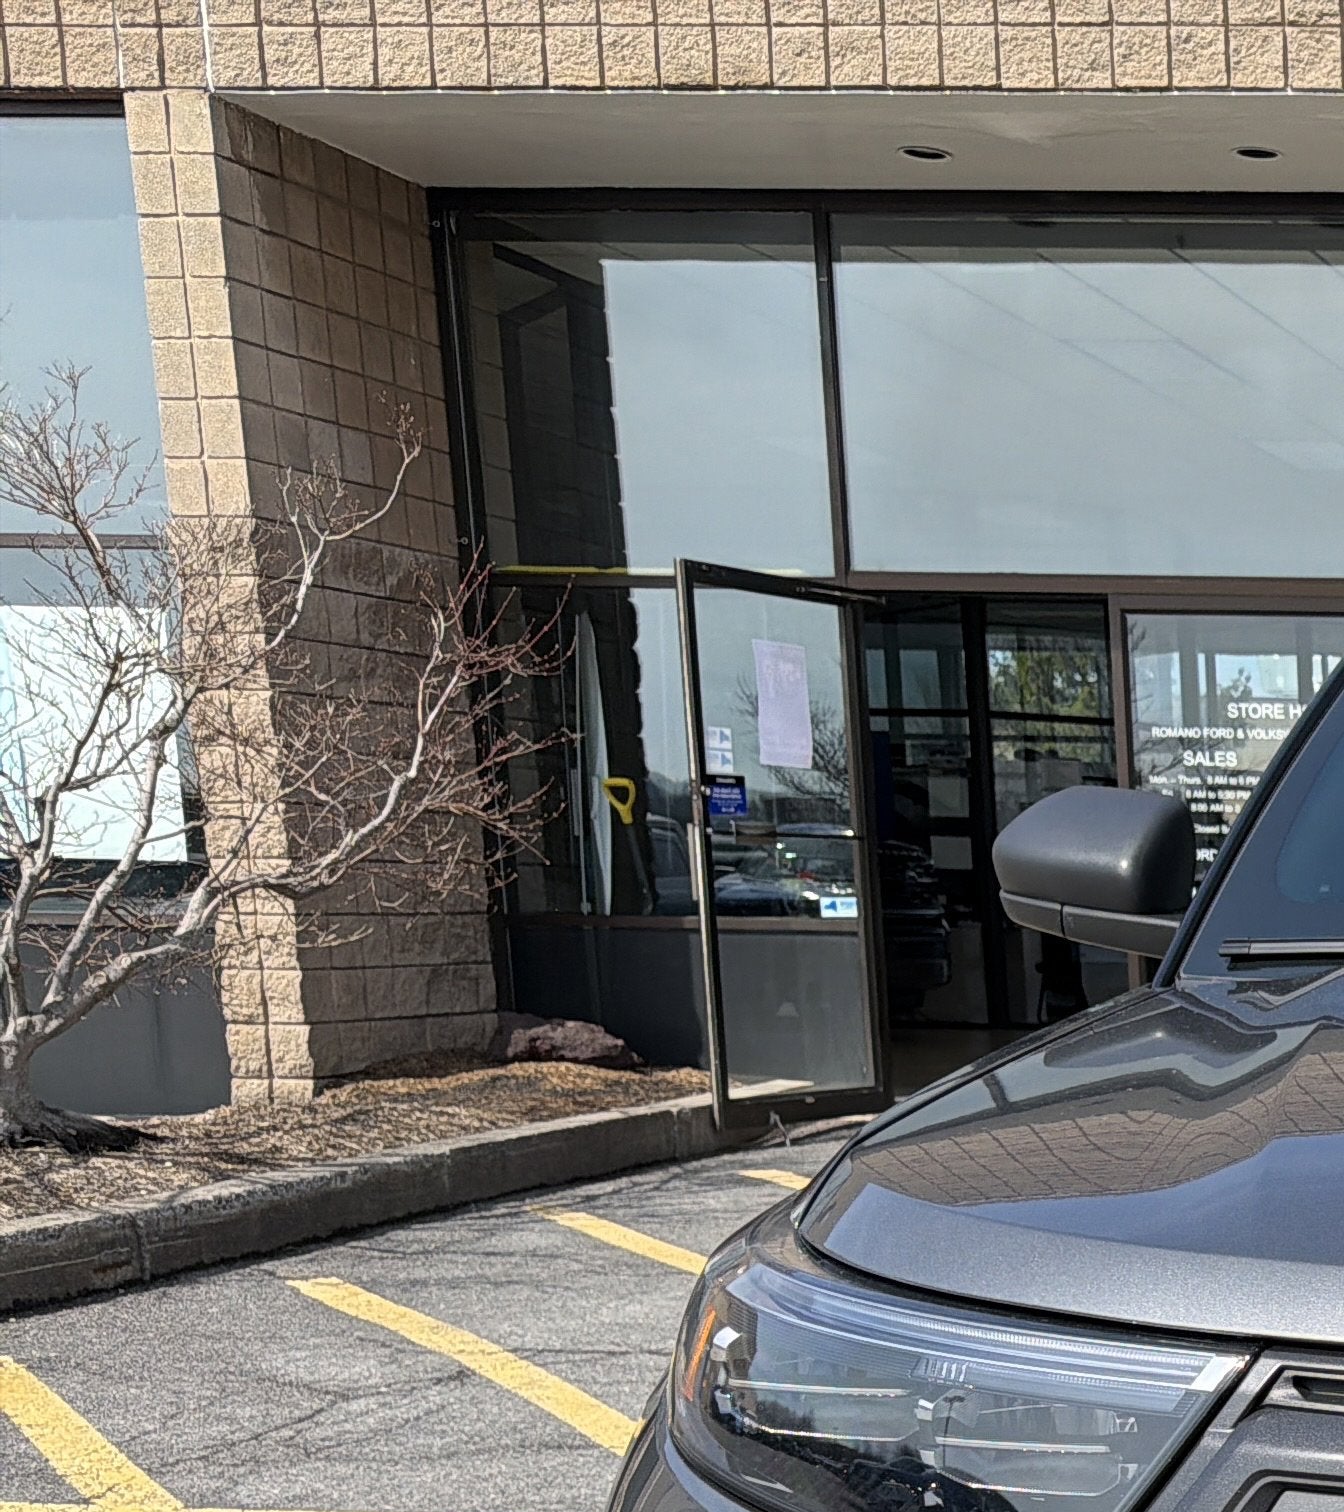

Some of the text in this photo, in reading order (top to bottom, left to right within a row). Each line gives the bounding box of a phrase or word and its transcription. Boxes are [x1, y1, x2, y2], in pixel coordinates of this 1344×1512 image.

[1227, 702, 1285, 720] STORE
[1152, 726, 1201, 739] ROMANO
[1204, 727, 1234, 739] FORD
[1236, 728, 1244, 739] &
[1183, 750, 1237, 767] SALES
[1214, 776, 1228, 785] AM
[1193, 789, 1206, 799] AM
[1209, 803, 1223, 812] AM
